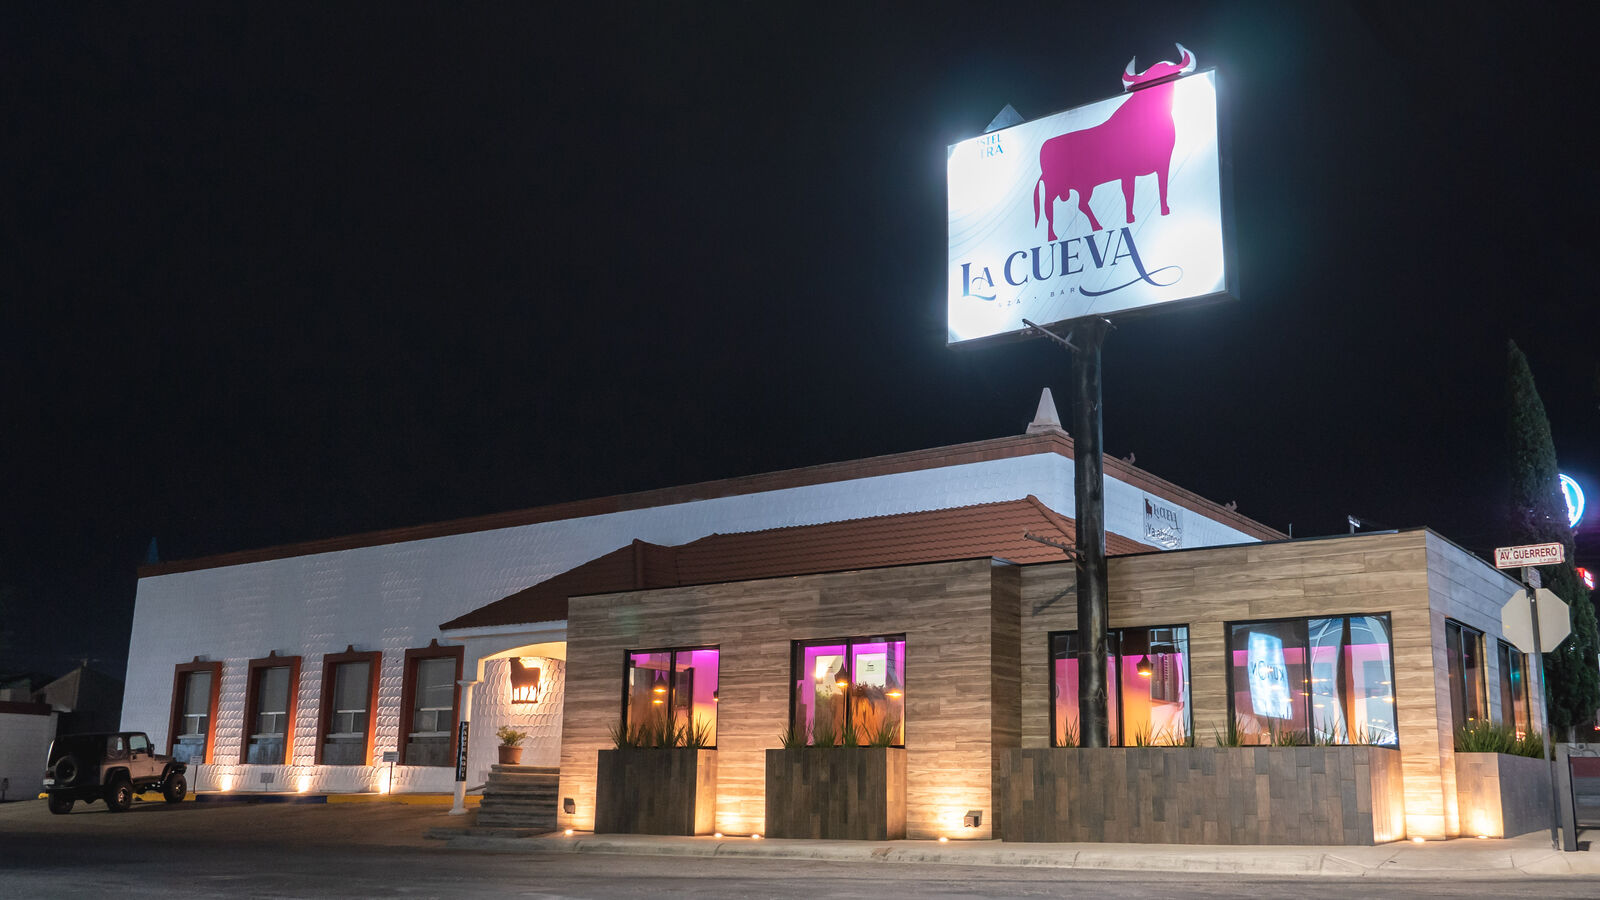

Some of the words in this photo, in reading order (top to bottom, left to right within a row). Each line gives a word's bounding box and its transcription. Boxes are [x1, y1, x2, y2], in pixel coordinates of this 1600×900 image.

[1003, 226, 1183, 297] CUEVA
[1050, 286, 1076, 298] BAR
[1500, 551, 1511, 561] AV.
[1513, 547, 1557, 560] GUERRERO
